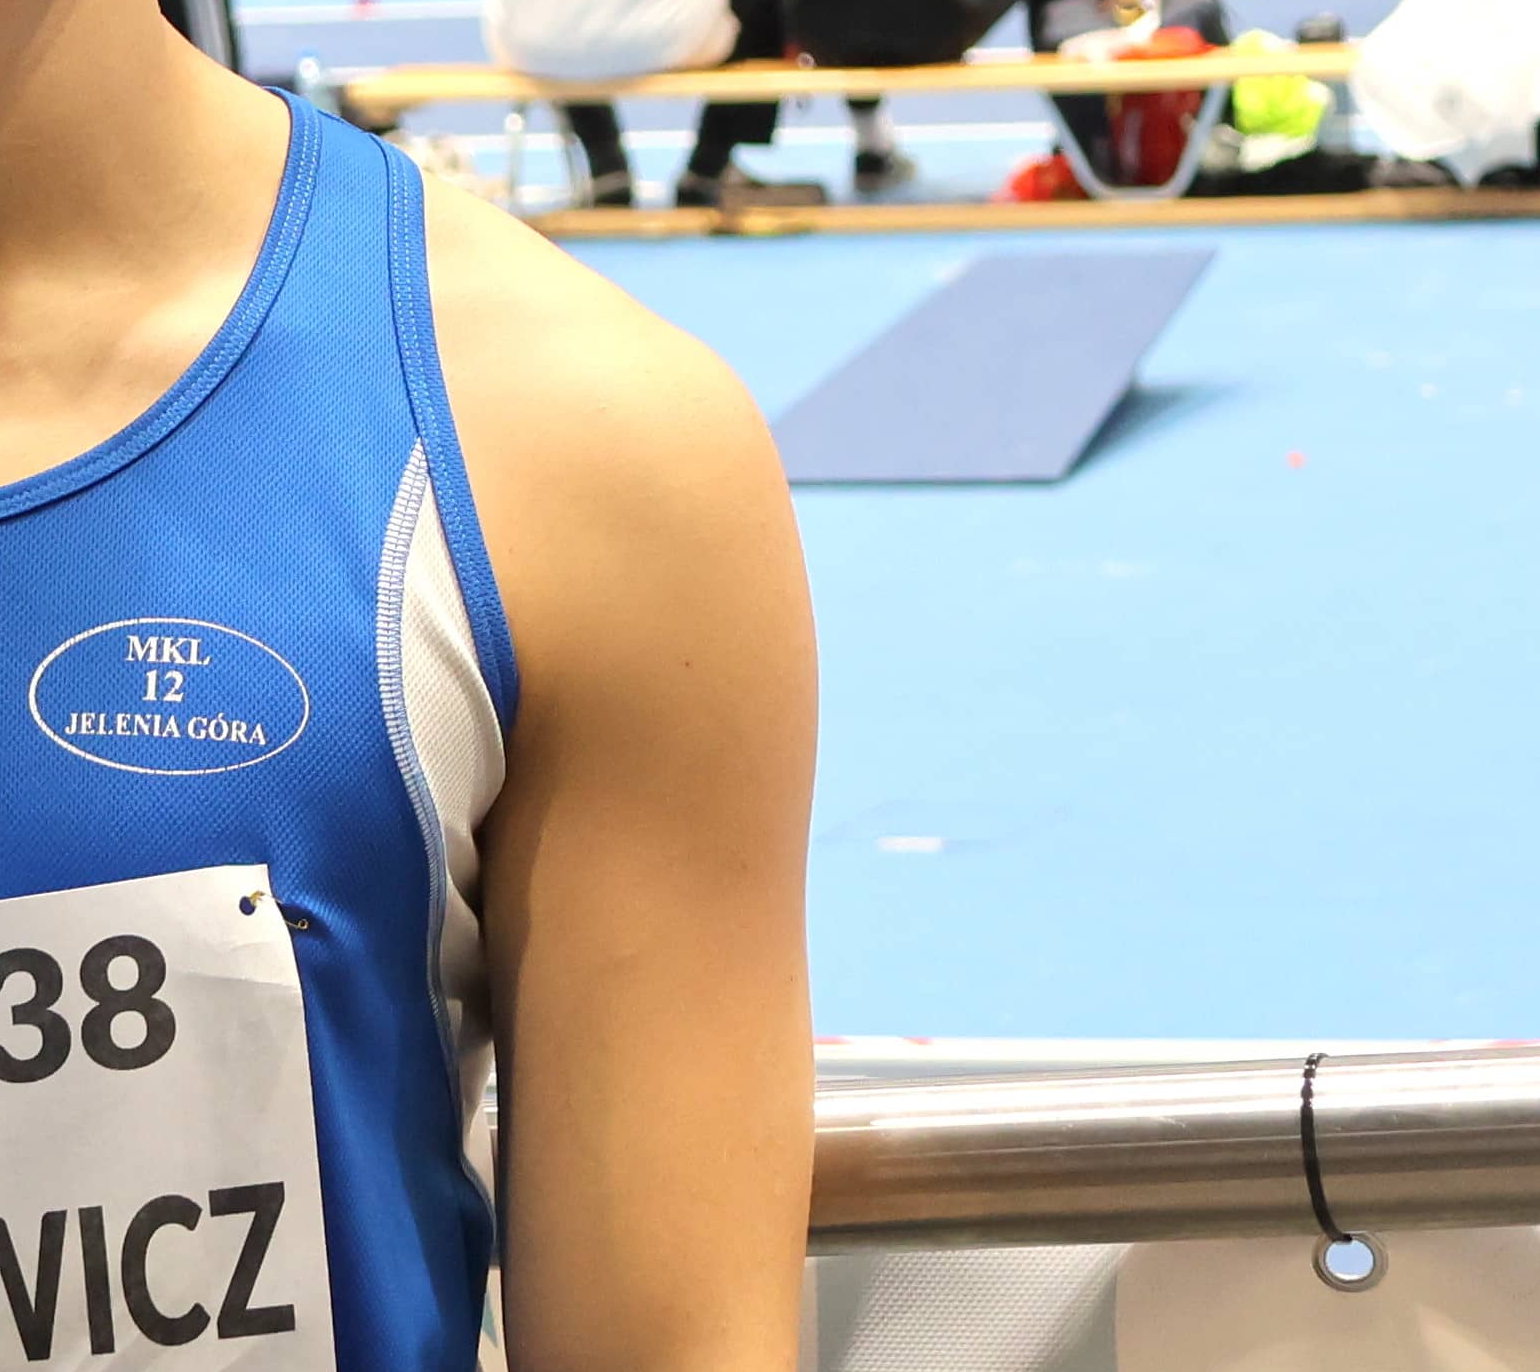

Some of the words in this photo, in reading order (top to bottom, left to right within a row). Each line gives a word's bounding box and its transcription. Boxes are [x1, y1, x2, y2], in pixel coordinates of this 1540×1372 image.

[125, 635, 212, 666] MKL
[141, 669, 185, 703] 12
[64, 712, 182, 739] JELENIA
[187, 713, 267, 746] GÓRA
